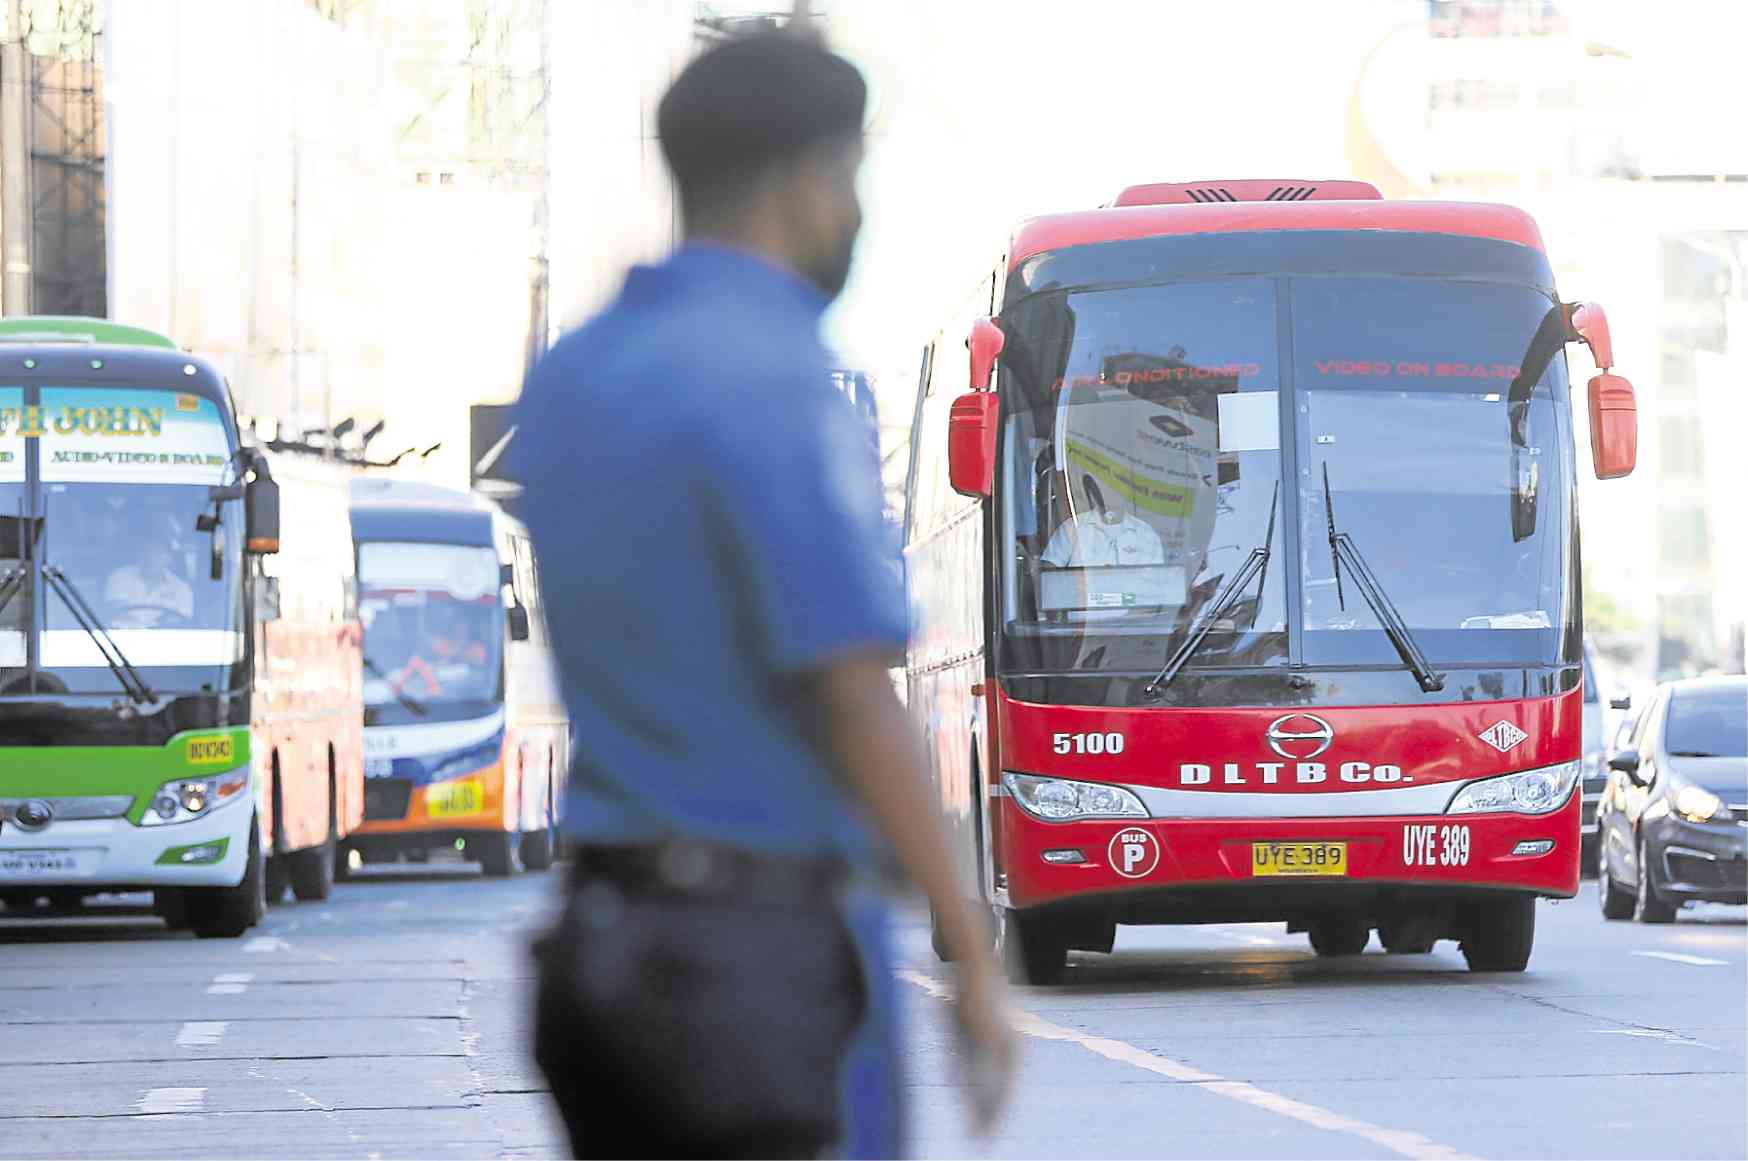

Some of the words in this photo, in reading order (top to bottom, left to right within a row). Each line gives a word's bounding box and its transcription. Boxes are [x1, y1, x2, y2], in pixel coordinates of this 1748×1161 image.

[1314, 359, 1392, 377] VIDEO
[1396, 360, 1429, 377] ON
[54, 406, 163, 437] JOHN
[1053, 732, 1124, 754] 5100
[1121, 833, 1148, 843] BUS
[1403, 824, 1437, 866] UYE
[1440, 824, 1470, 867] 389
[1124, 844, 1145, 872] P
[1256, 847, 1296, 865] UYE
[1302, 847, 1341, 865] 389
